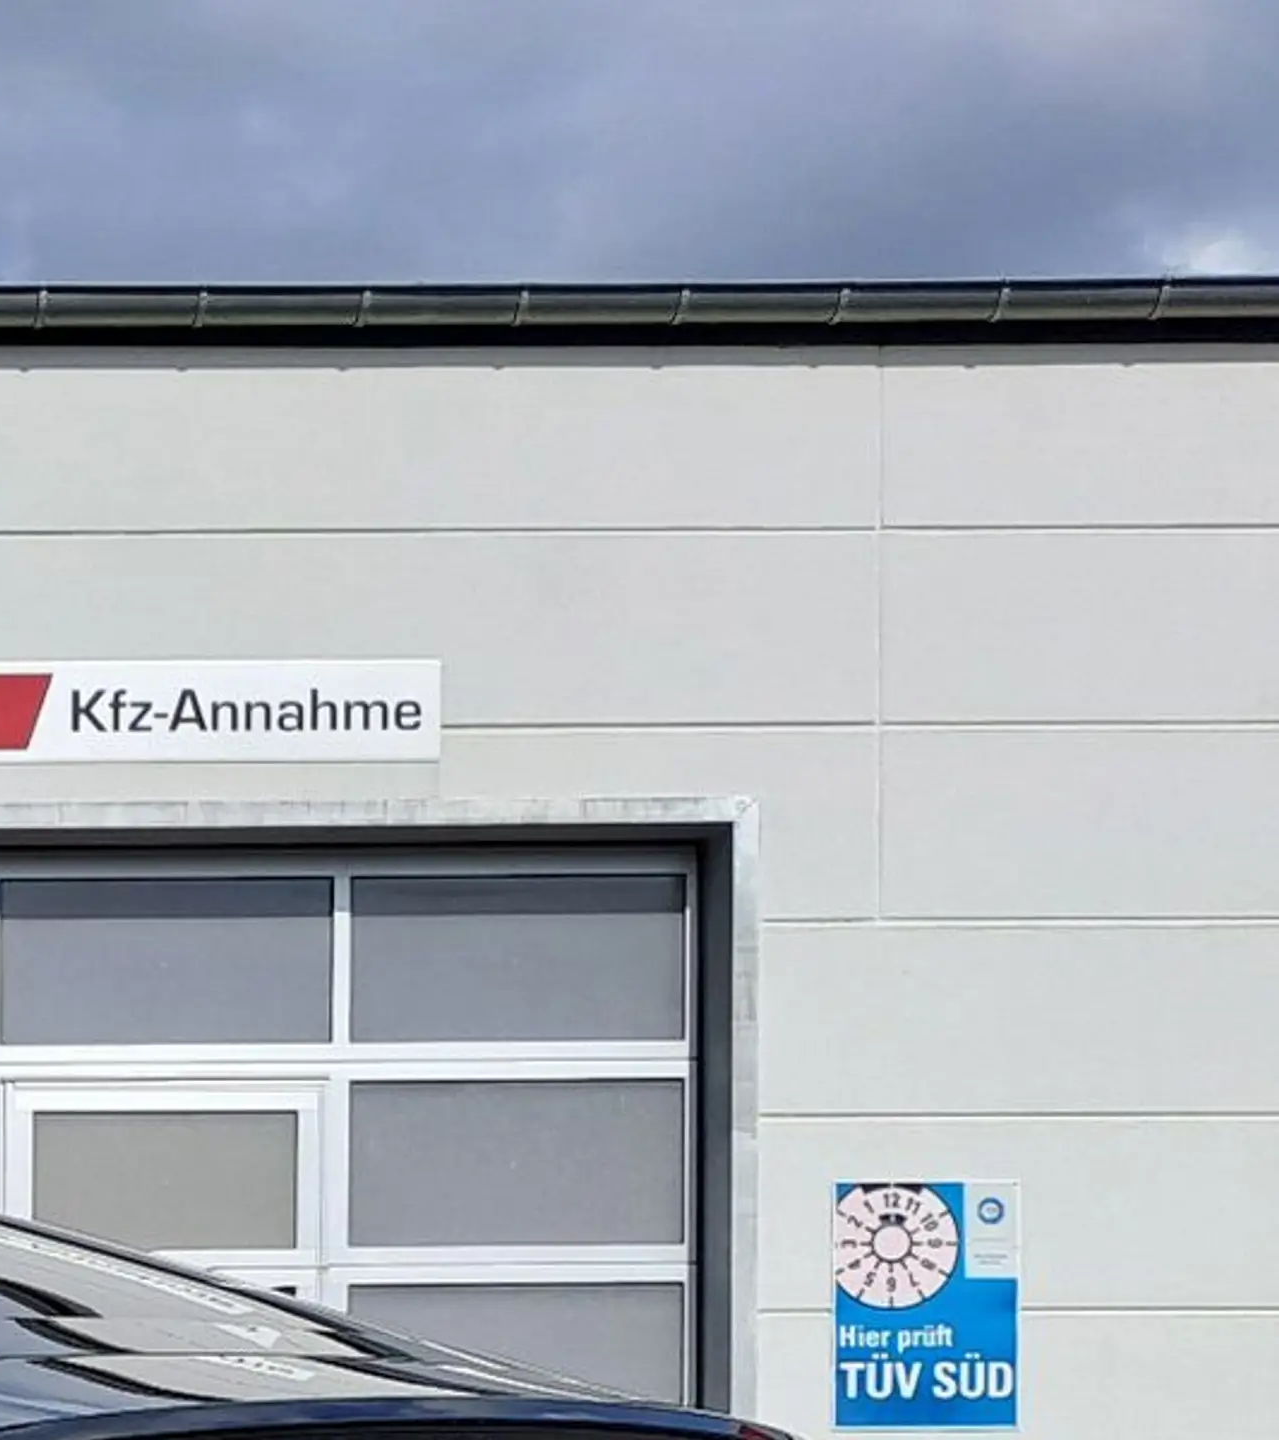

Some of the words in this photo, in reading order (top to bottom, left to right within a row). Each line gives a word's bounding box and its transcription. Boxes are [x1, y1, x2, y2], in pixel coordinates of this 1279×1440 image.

[70, 688, 423, 732] Kfz-Annahme
[883, 1192, 900, 1208] 12
[905, 1197, 922, 1214] 11
[920, 1213, 939, 1231] 10
[839, 1325, 890, 1348] Hier
[897, 1324, 954, 1354] prüft
[839, 1353, 923, 1399] TÜV
[932, 1353, 1014, 1399] SÜD
